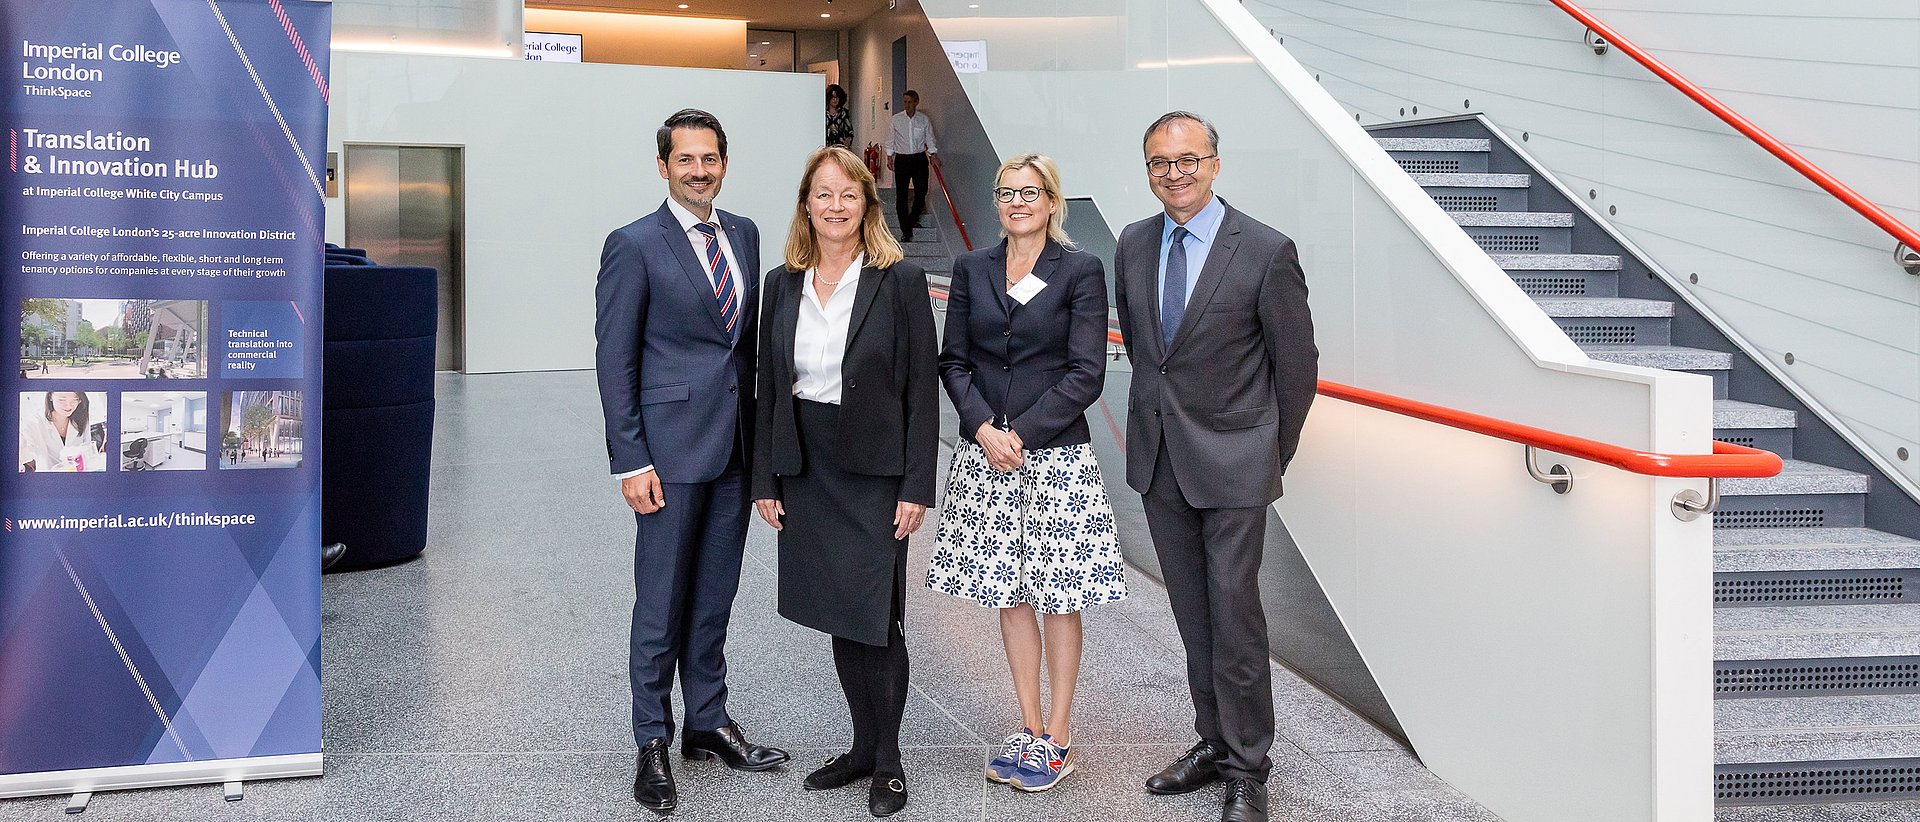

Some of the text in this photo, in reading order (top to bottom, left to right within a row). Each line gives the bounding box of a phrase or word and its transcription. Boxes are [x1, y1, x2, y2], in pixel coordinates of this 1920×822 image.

[24, 40, 180, 69] Imperial College
[544, 43, 577, 54] College
[23, 62, 102, 81] London
[24, 85, 91, 99] ThinkSpace
[23, 129, 149, 151] Translation
[24, 155, 218, 178] & Innovation Hub
[23, 187, 223, 202] at Imperial College White City Campus
[23, 225, 296, 240] Imperial College London’s 25-acre Innovation District
[22, 251, 59, 262] Offering
[68, 252, 98, 262] variety
[101, 253, 110, 261] of
[112, 253, 160, 263] affordable,
[162, 254, 197, 263] flexible,
[199, 255, 222, 263] short
[224, 255, 240, 263] and
[243, 255, 262, 265] long
[22, 265, 58, 275] tenancy
[60, 266, 93, 275] options
[96, 266, 108, 274] for
[110, 267, 158, 276] companies
[172, 269, 195, 277] every
[197, 268, 221, 277] stage
[223, 268, 233, 276] of
[234, 268, 254, 276] their
[256, 269, 285, 278] growth
[228, 340, 292, 348] translation into
[228, 361, 255, 370] reality
[18, 512, 256, 531] www.imperial.ac.uk/thinkspace
